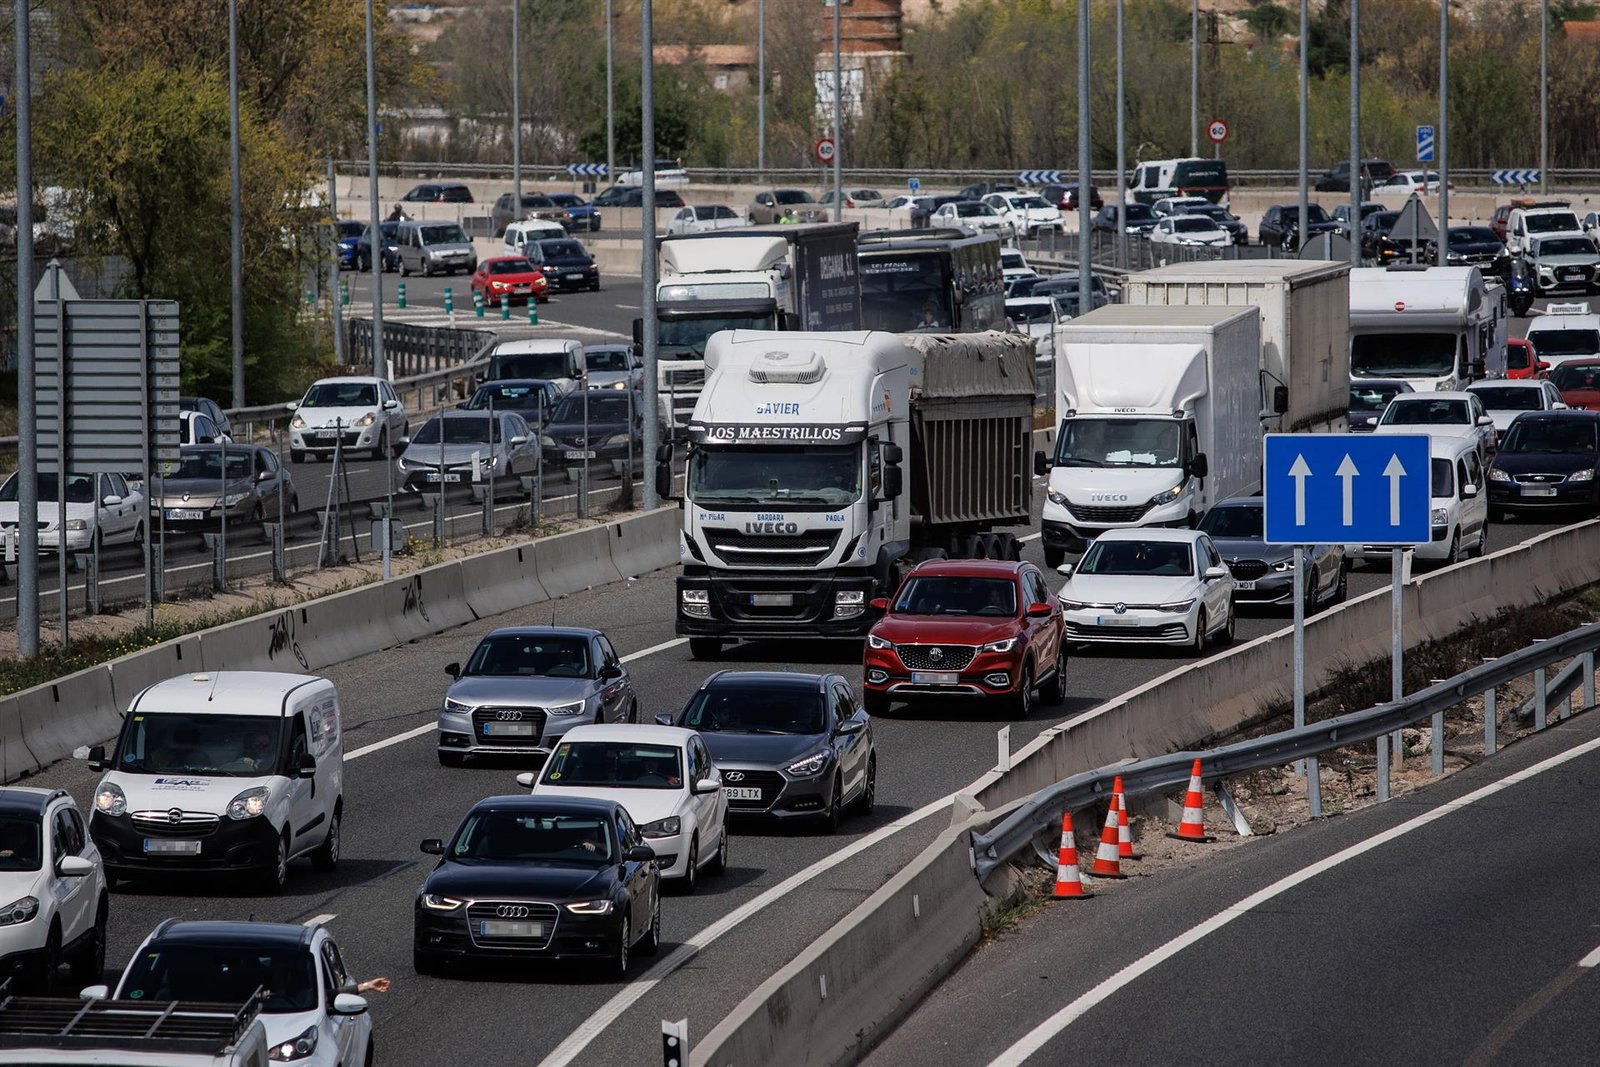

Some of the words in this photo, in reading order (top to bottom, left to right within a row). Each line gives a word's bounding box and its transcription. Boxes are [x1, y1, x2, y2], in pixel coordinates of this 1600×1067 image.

[708, 427, 735, 439] LOS
[738, 426, 842, 440] MAESTRILLOS
[1091, 494, 1128, 502] IVECO
[825, 514, 845, 522] PAOLA
[745, 522, 798, 534] IVECO
[741, 789, 759, 798] LTX
